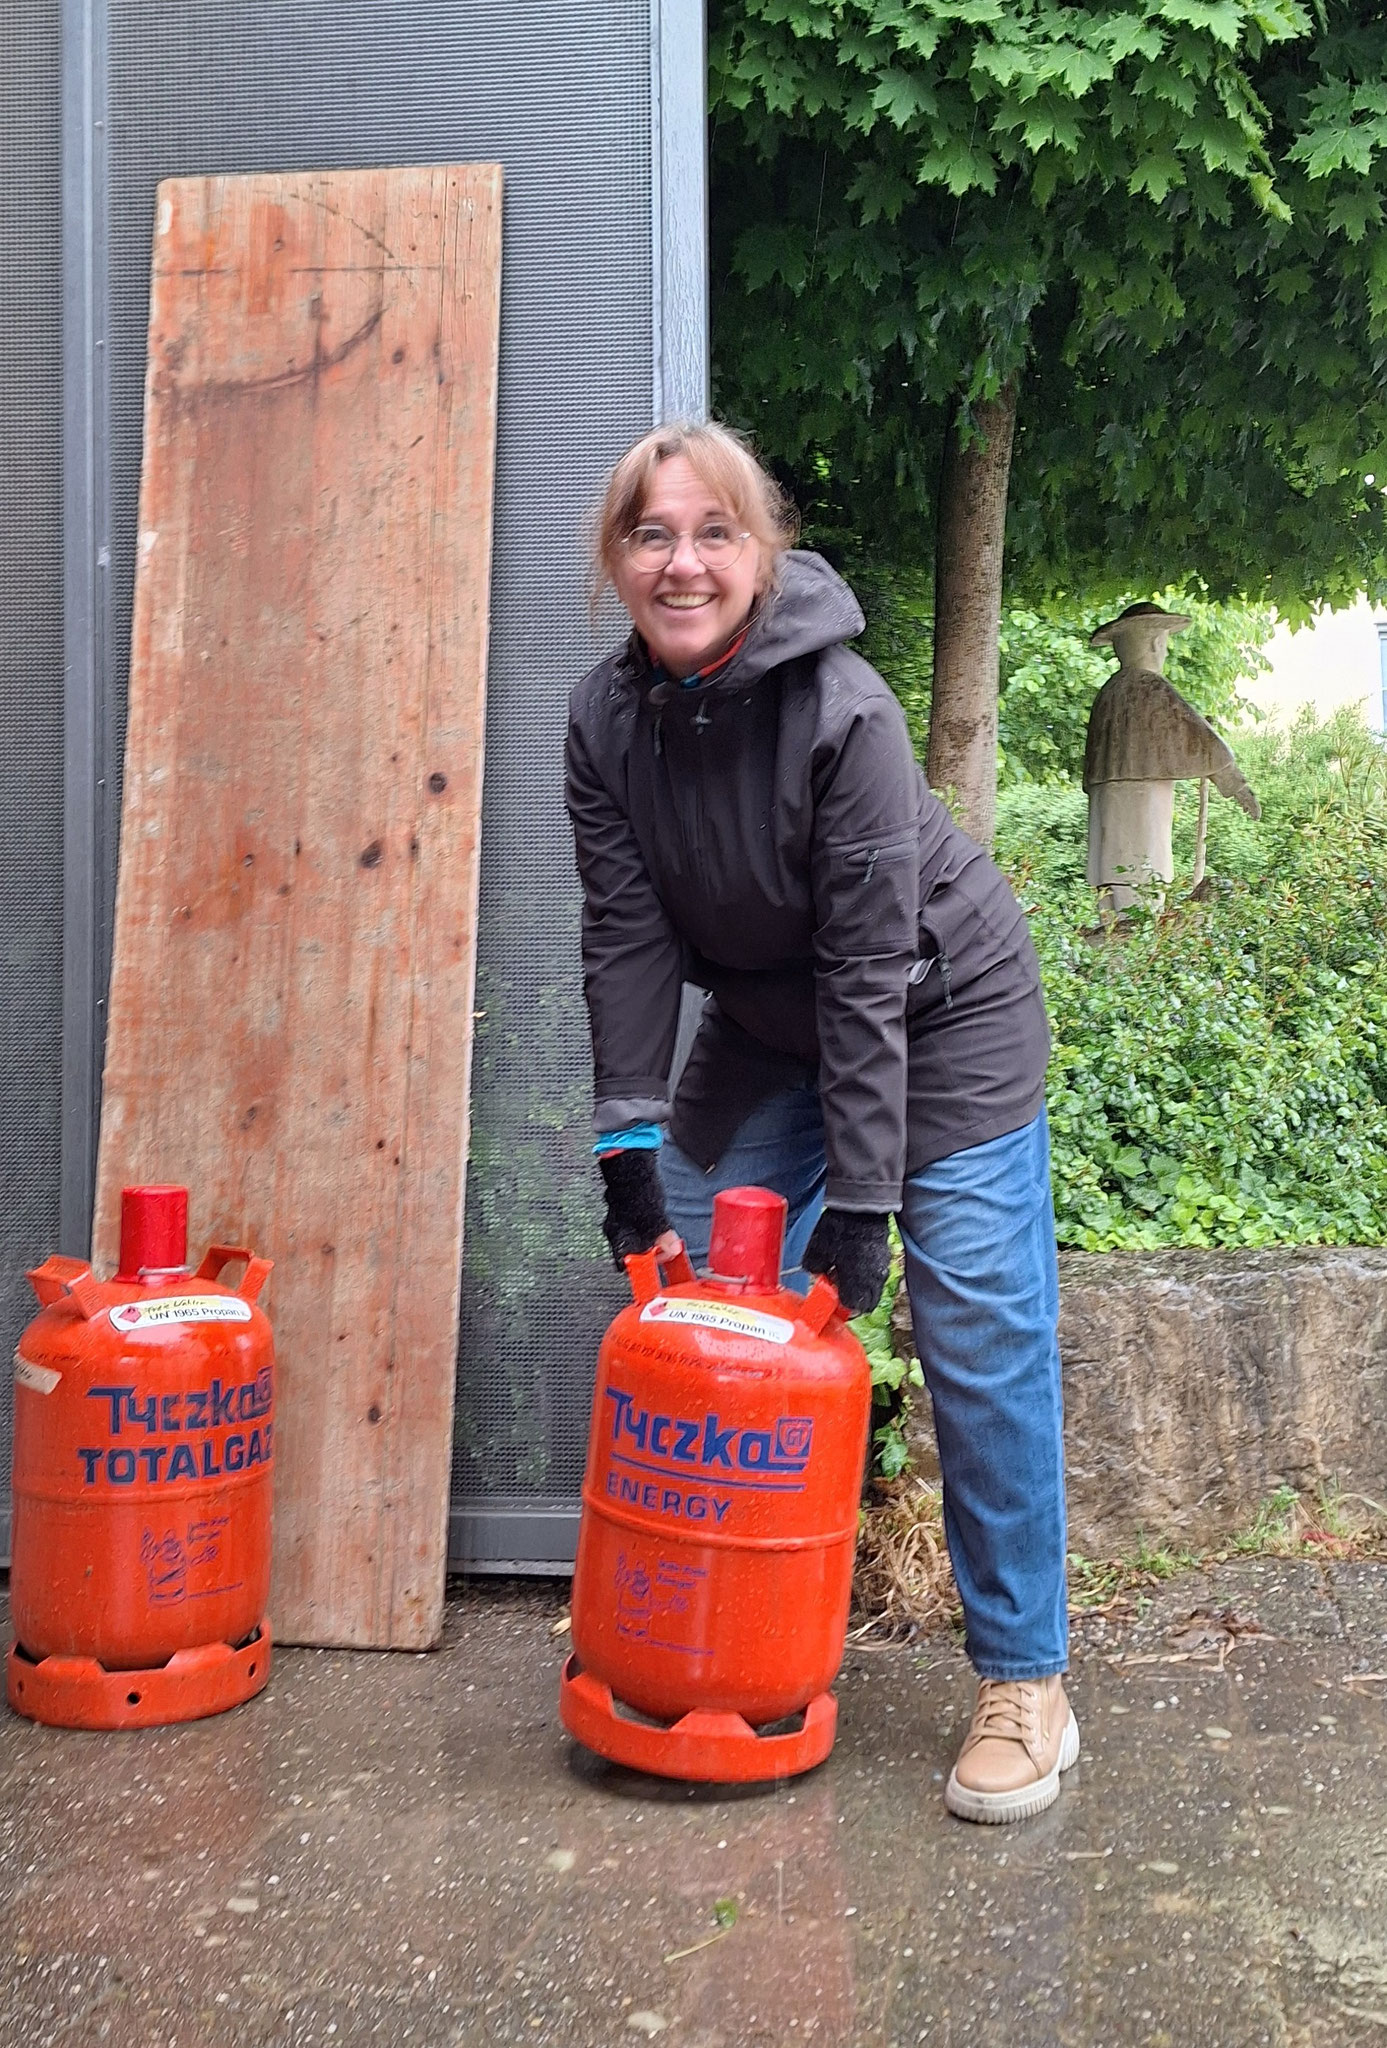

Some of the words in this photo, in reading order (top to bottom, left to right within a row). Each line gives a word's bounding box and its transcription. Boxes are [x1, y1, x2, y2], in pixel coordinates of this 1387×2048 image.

[150, 1311, 170, 1321] UN
[173, 1308, 199, 1318] 1965
[201, 1307, 240, 1317] Propan
[668, 1310, 687, 1319] UN
[691, 1311, 717, 1323] 1965
[719, 1317, 766, 1336] Propan
[87, 1379, 272, 1434] Tyczka
[606, 1387, 807, 1472] Tyczka
[607, 1472, 732, 1523] ENERGY
